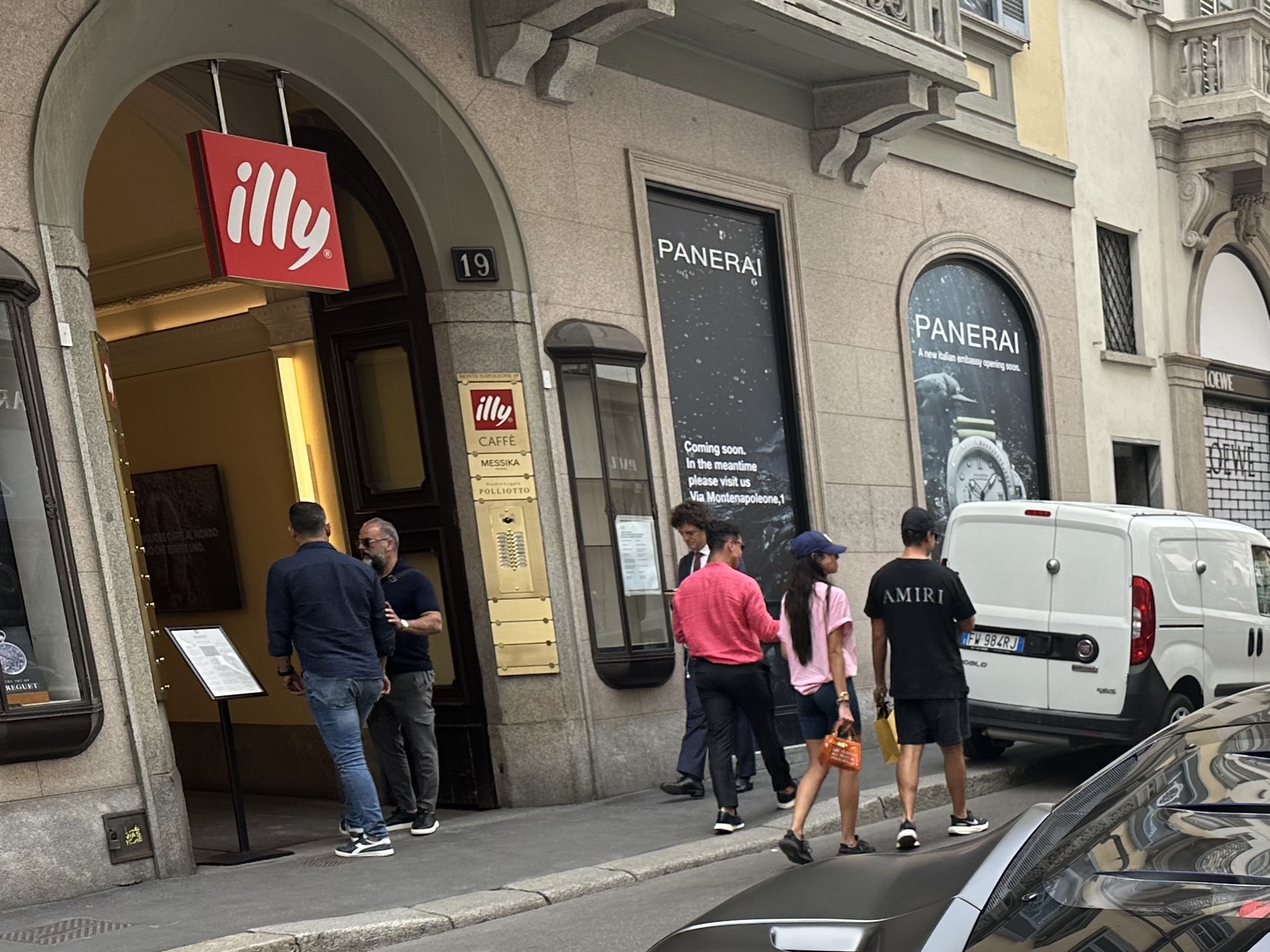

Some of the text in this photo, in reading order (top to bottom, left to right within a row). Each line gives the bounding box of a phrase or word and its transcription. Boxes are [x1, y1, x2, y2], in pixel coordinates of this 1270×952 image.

[227, 161, 331, 271] illy
[460, 253, 490, 277] 19
[657, 238, 762, 277] PANERAI
[915, 314, 1020, 355] PANERAI
[918, 347, 924, 357] A
[924, 350, 937, 360] new
[957, 354, 983, 367] embassy
[983, 360, 1005, 372] opening
[1205, 370, 1234, 392] LOEWE
[475, 395, 512, 427] illy
[478, 433, 516, 447] CAFFÈ
[684, 440, 746, 456] Coming soon.
[481, 459, 520, 467] MESSIKA
[686, 457, 757, 472] In the meantime
[1206, 441, 1255, 477] OEWE
[688, 475, 751, 488] please visit us
[479, 487, 530, 495] POLLIOTTO
[690, 491, 704, 502] Via
[882, 587, 943, 605] AMIRI
[968, 632, 981, 645] FW
[983, 634, 1018, 650] 984RJ
